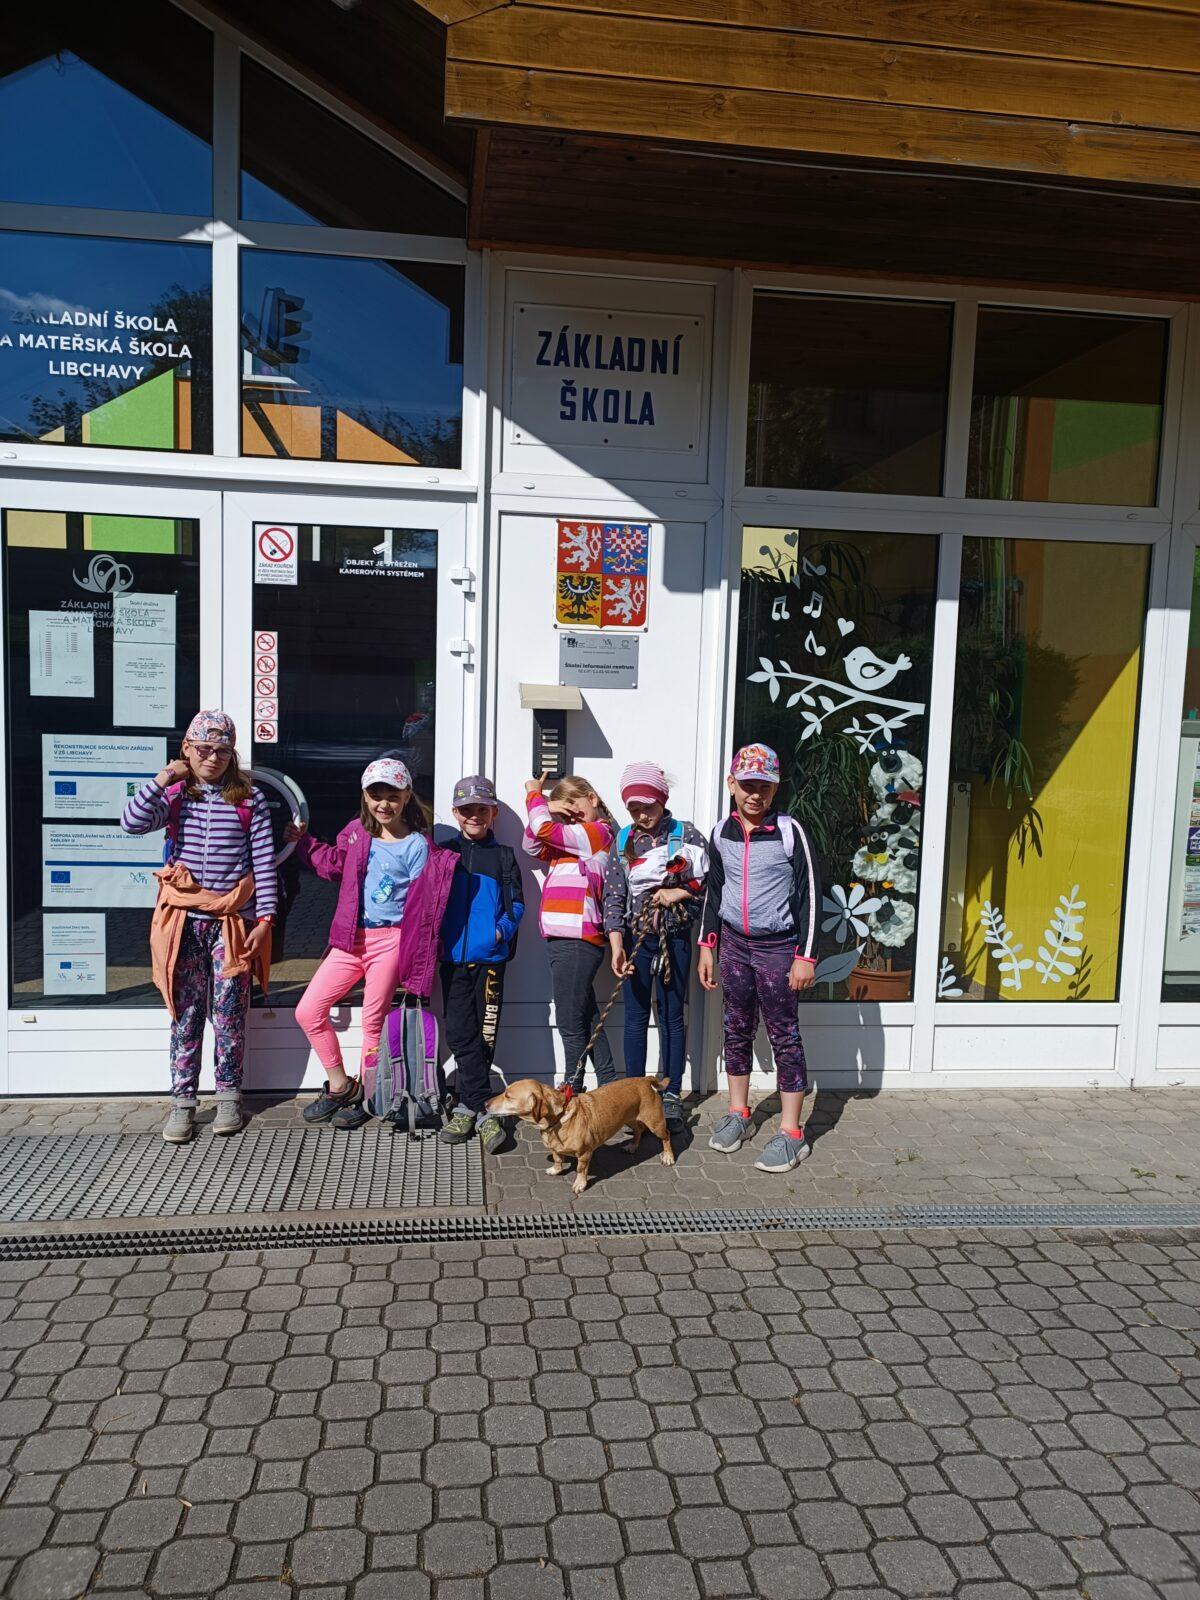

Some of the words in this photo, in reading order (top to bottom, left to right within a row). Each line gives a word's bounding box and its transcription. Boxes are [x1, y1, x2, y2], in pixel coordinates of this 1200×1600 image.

[114, 310, 178, 332] ŠKOLA
[0, 334, 13, 347] A
[19, 332, 123, 354] MATEŘSKÁ
[129, 338, 192, 358] ŠKOLA
[536, 325, 684, 375] ZÁKLADNÍ
[48, 360, 144, 380] LIBCHAVY
[560, 379, 655, 425] ŠKOLA
[339, 567, 385, 576] KAMEROVÝM
[387, 569, 424, 578] SYSTÉMEM
[346, 559, 374, 567] OBJEKT
[386, 560, 418, 568] STŘEŽEN
[60, 599, 110, 610] ZÁKLADNÍ
